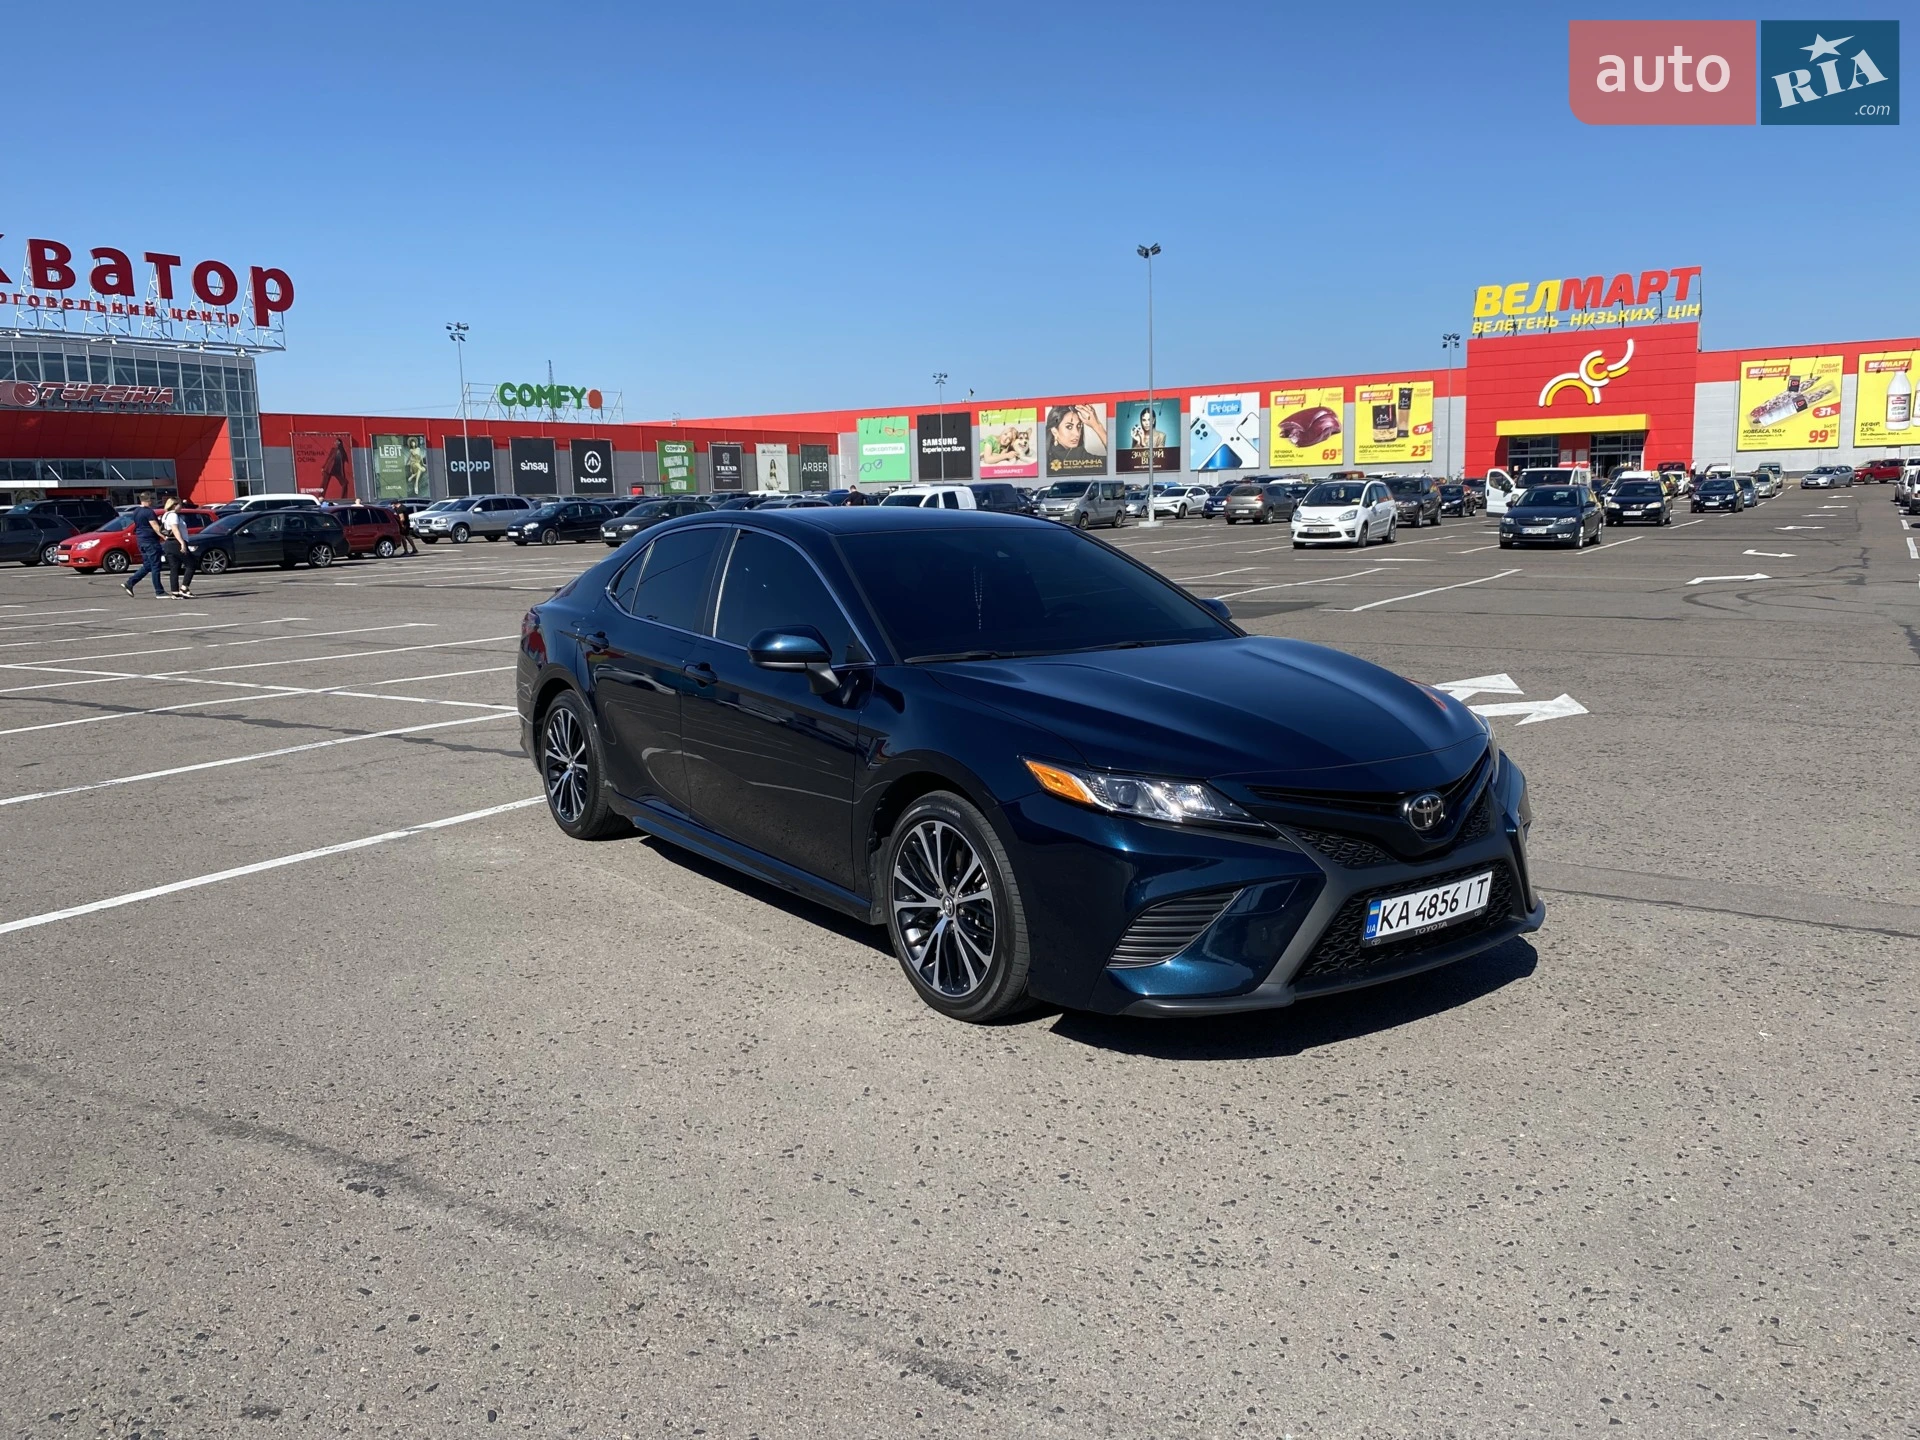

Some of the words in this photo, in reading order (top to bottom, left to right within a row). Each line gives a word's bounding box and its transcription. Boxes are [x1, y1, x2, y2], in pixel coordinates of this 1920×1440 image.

[0, 233, 294, 327] ватор
[1473, 266, 1701, 318] ВЕЛМАРТ
[170, 307, 240, 327] центр
[1472, 315, 1559, 334] ВЕЛЕТЕНЬ
[1569, 307, 1656, 327] НИЗЬКИХ
[1667, 303, 1701, 320] ЦІН
[1749, 366, 1789, 375] ВЕЛМАРТ
[498, 382, 587, 409] COMFY
[922, 437, 957, 446] SAMSUNG
[1808, 430, 1829, 443] 99
[379, 446, 402, 457] LEGIT
[1322, 448, 1337, 460] 69
[1410, 445, 1426, 457] 23
[450, 461, 491, 472] CROPP
[520, 460, 549, 473] sinsay
[802, 462, 828, 472] ARBER
[1379, 900, 1410, 932] KA
[1415, 885, 1460, 922] 4856
[1465, 878, 1488, 908] IT
[1366, 923, 1376, 934] UA
[1414, 921, 1448, 936] TOYOTA
